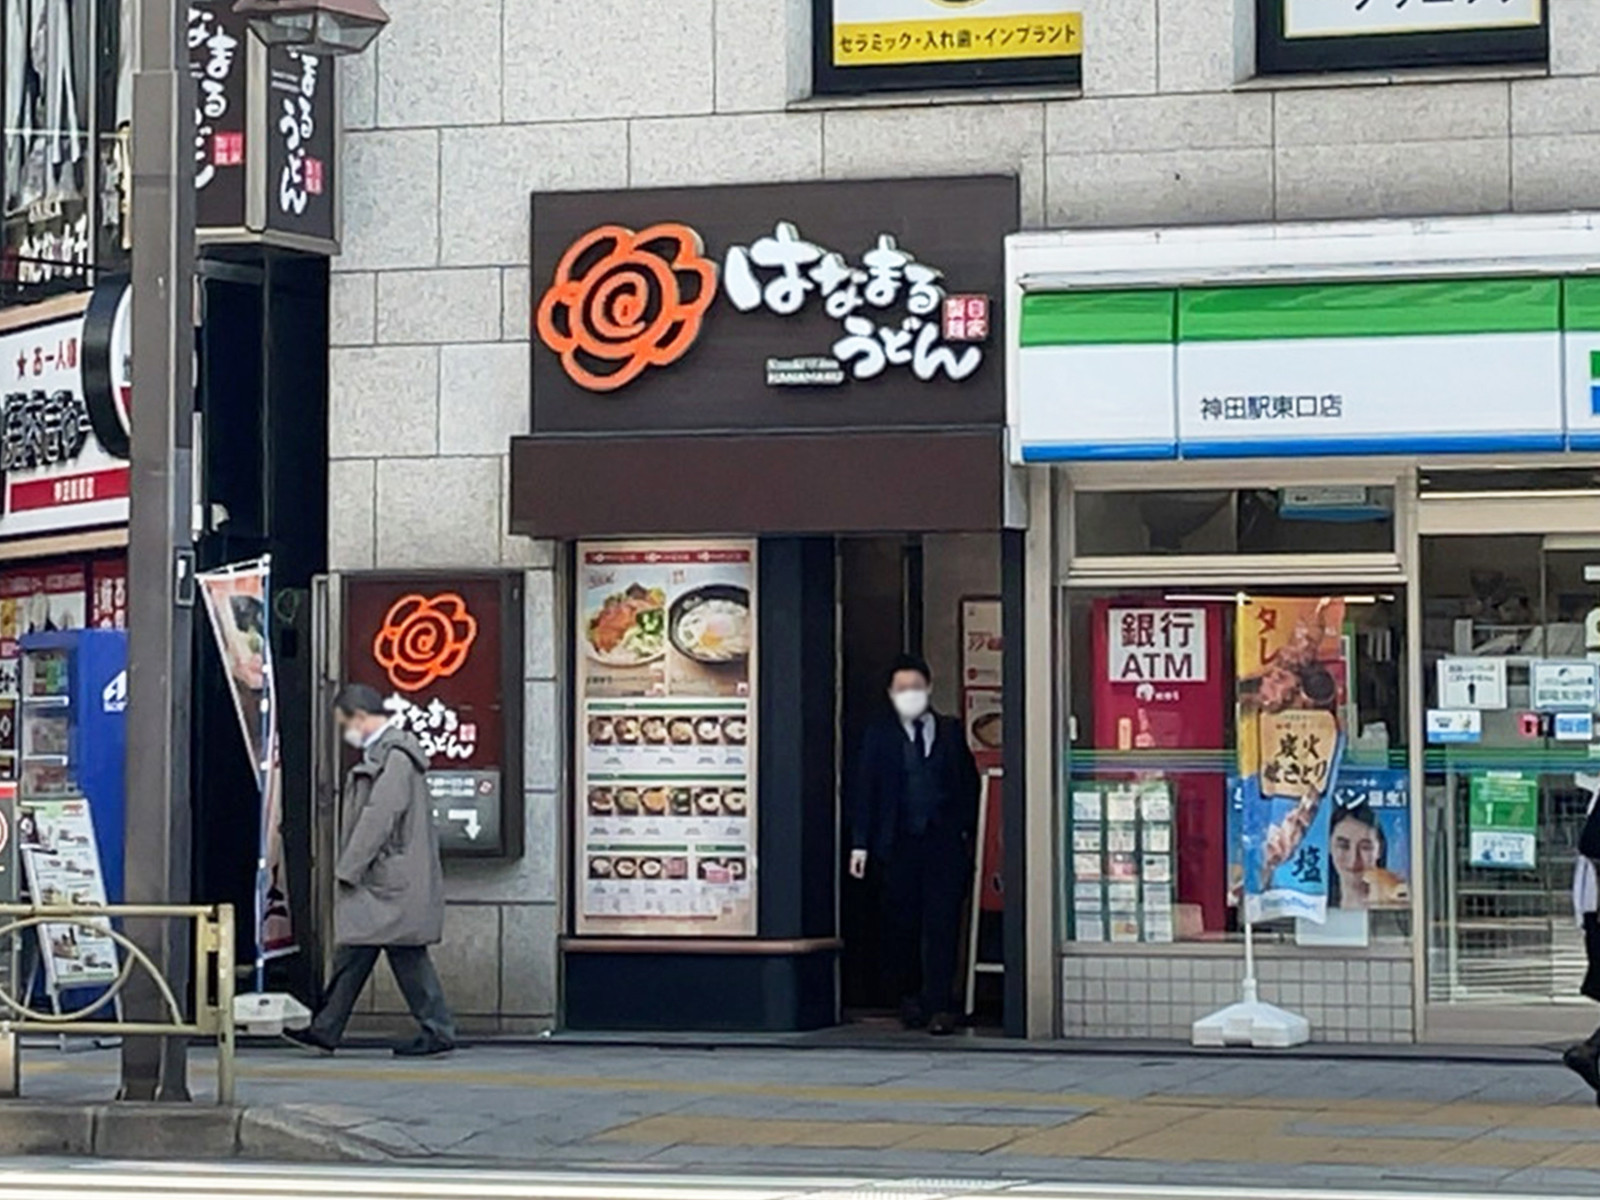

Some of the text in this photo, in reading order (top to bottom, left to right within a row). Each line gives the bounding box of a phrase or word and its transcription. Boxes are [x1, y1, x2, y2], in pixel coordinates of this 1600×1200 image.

[724, 221, 944, 318] はなまる
[832, 316, 982, 380] うどん
[1200, 394, 1342, 420] 神田駅東口店
[1121, 612, 1194, 648] 銀行
[1257, 606, 1278, 666] タレ
[1121, 653, 1192, 679] ATM
[419, 732, 474, 759] うどん
[1291, 845, 1322, 883] 塩
